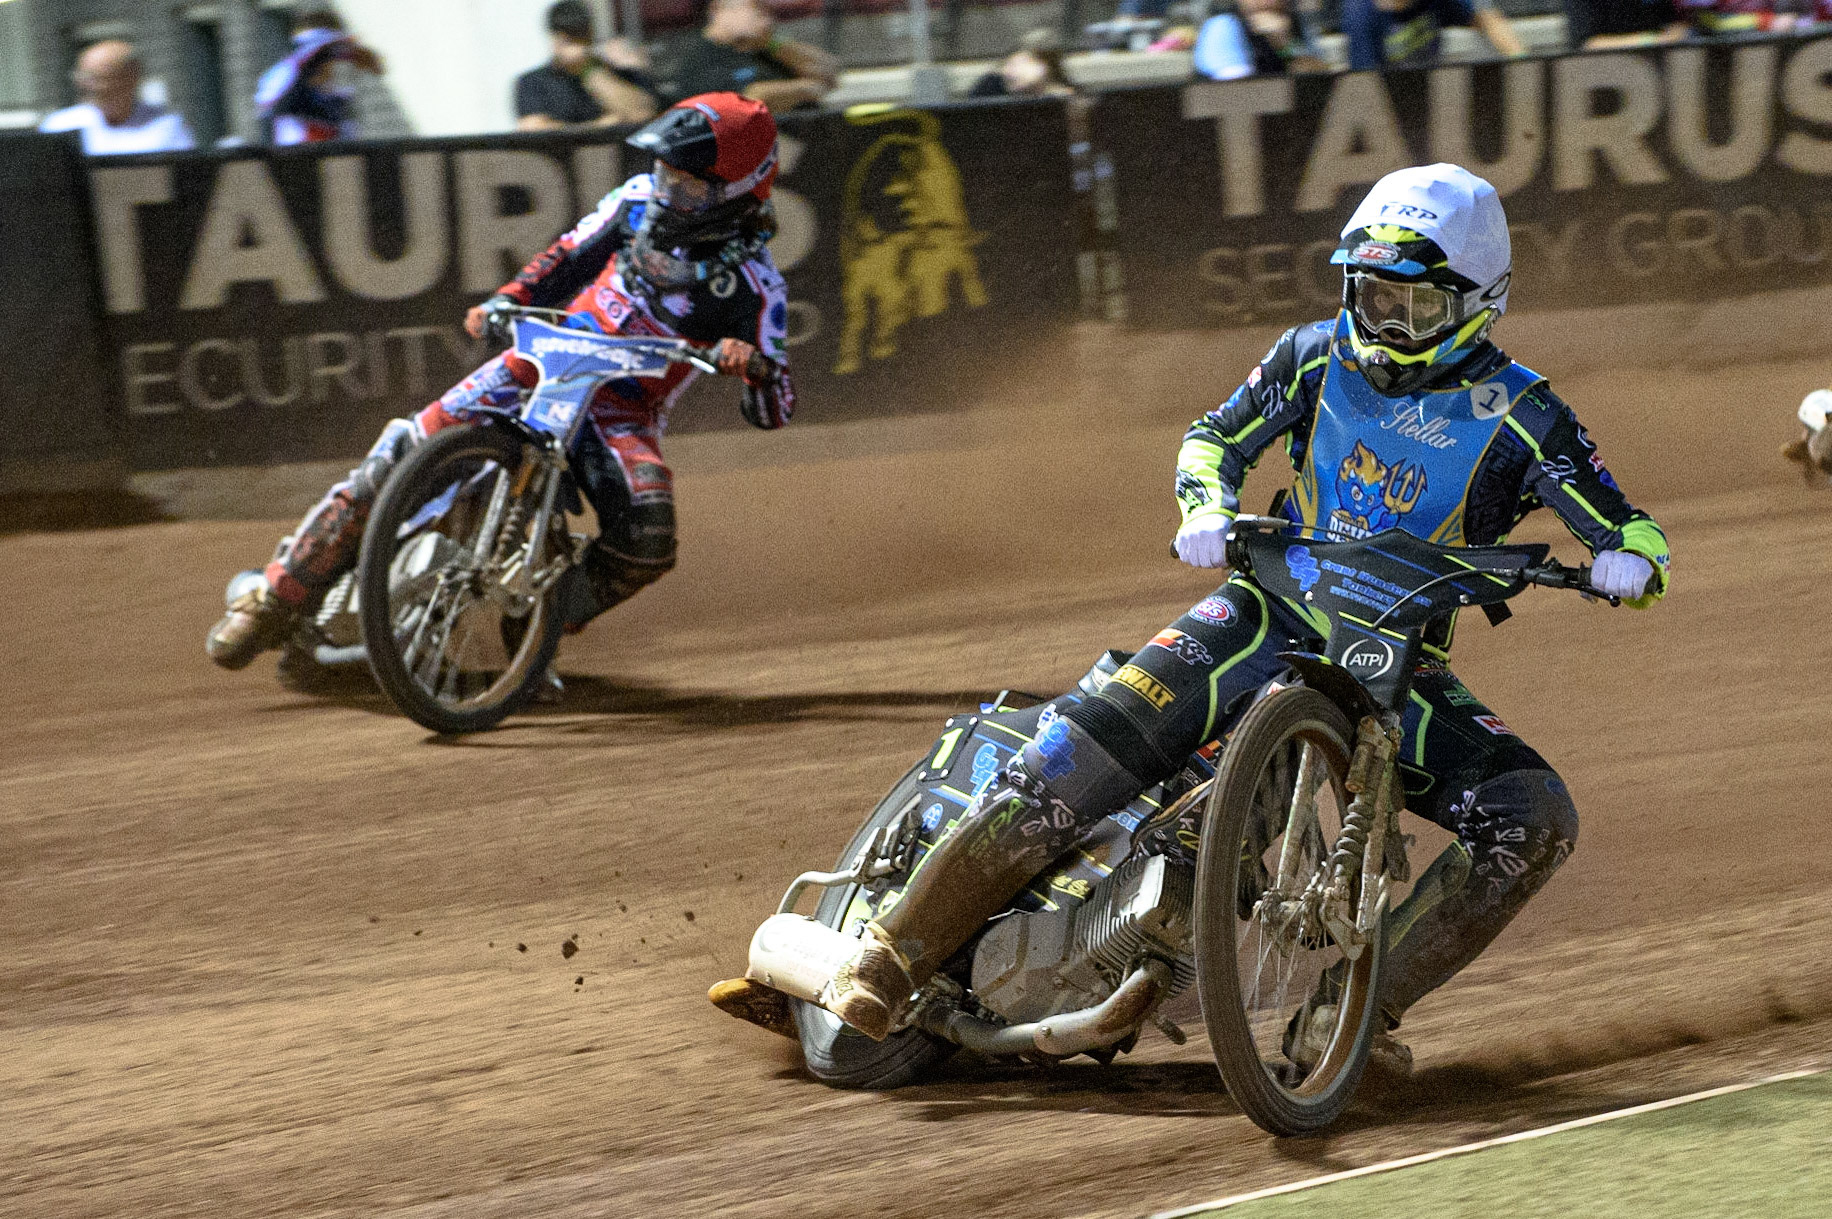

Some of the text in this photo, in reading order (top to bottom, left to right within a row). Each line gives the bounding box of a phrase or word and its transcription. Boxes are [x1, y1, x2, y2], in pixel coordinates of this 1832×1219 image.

[90, 130, 815, 314] TAUR
[1479, 389, 1500, 413] 1
[1380, 401, 1457, 449] Stellar
[1349, 653, 1385, 667] ATPI
[931, 728, 964, 769] 1
